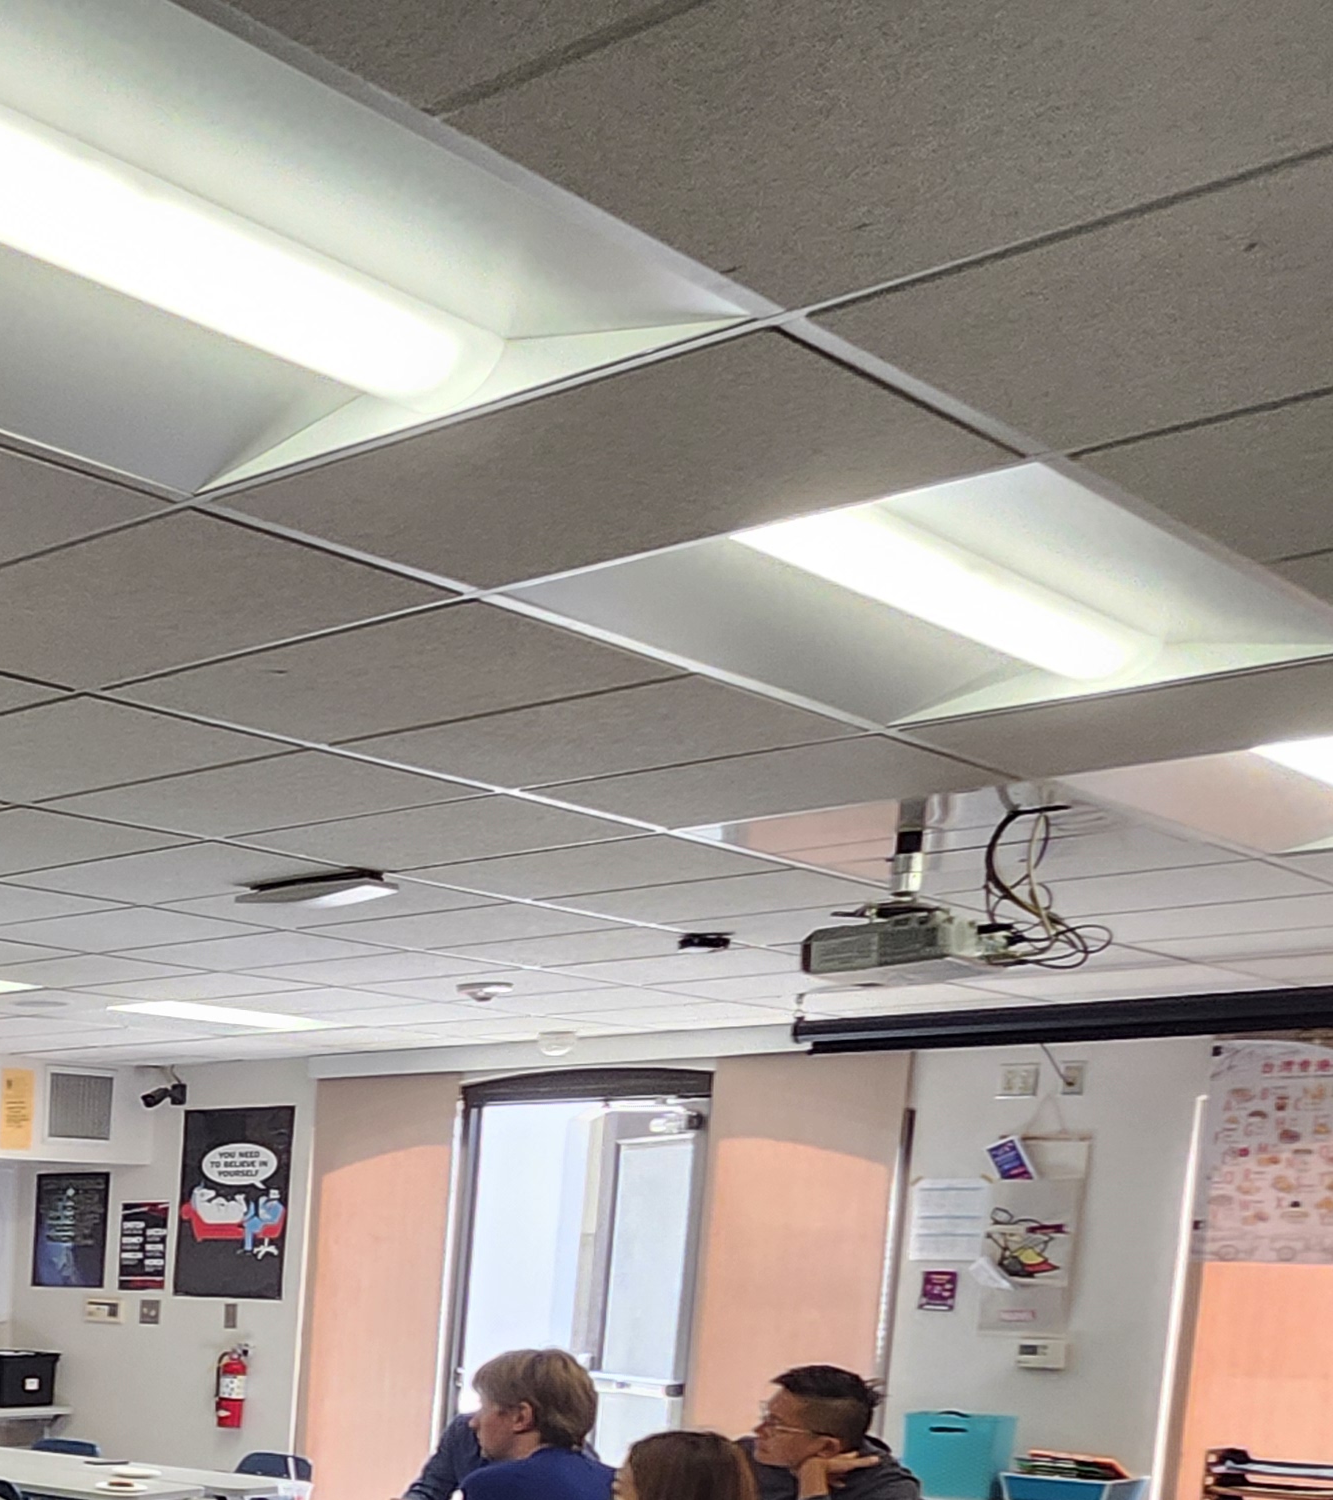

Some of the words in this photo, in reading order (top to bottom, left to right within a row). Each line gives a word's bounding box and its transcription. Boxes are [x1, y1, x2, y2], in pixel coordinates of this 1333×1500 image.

[218, 1151, 236, 1159] YOU
[223, 1160, 256, 1168] BELIEVE
[218, 1169, 259, 1178] YOURSELF
